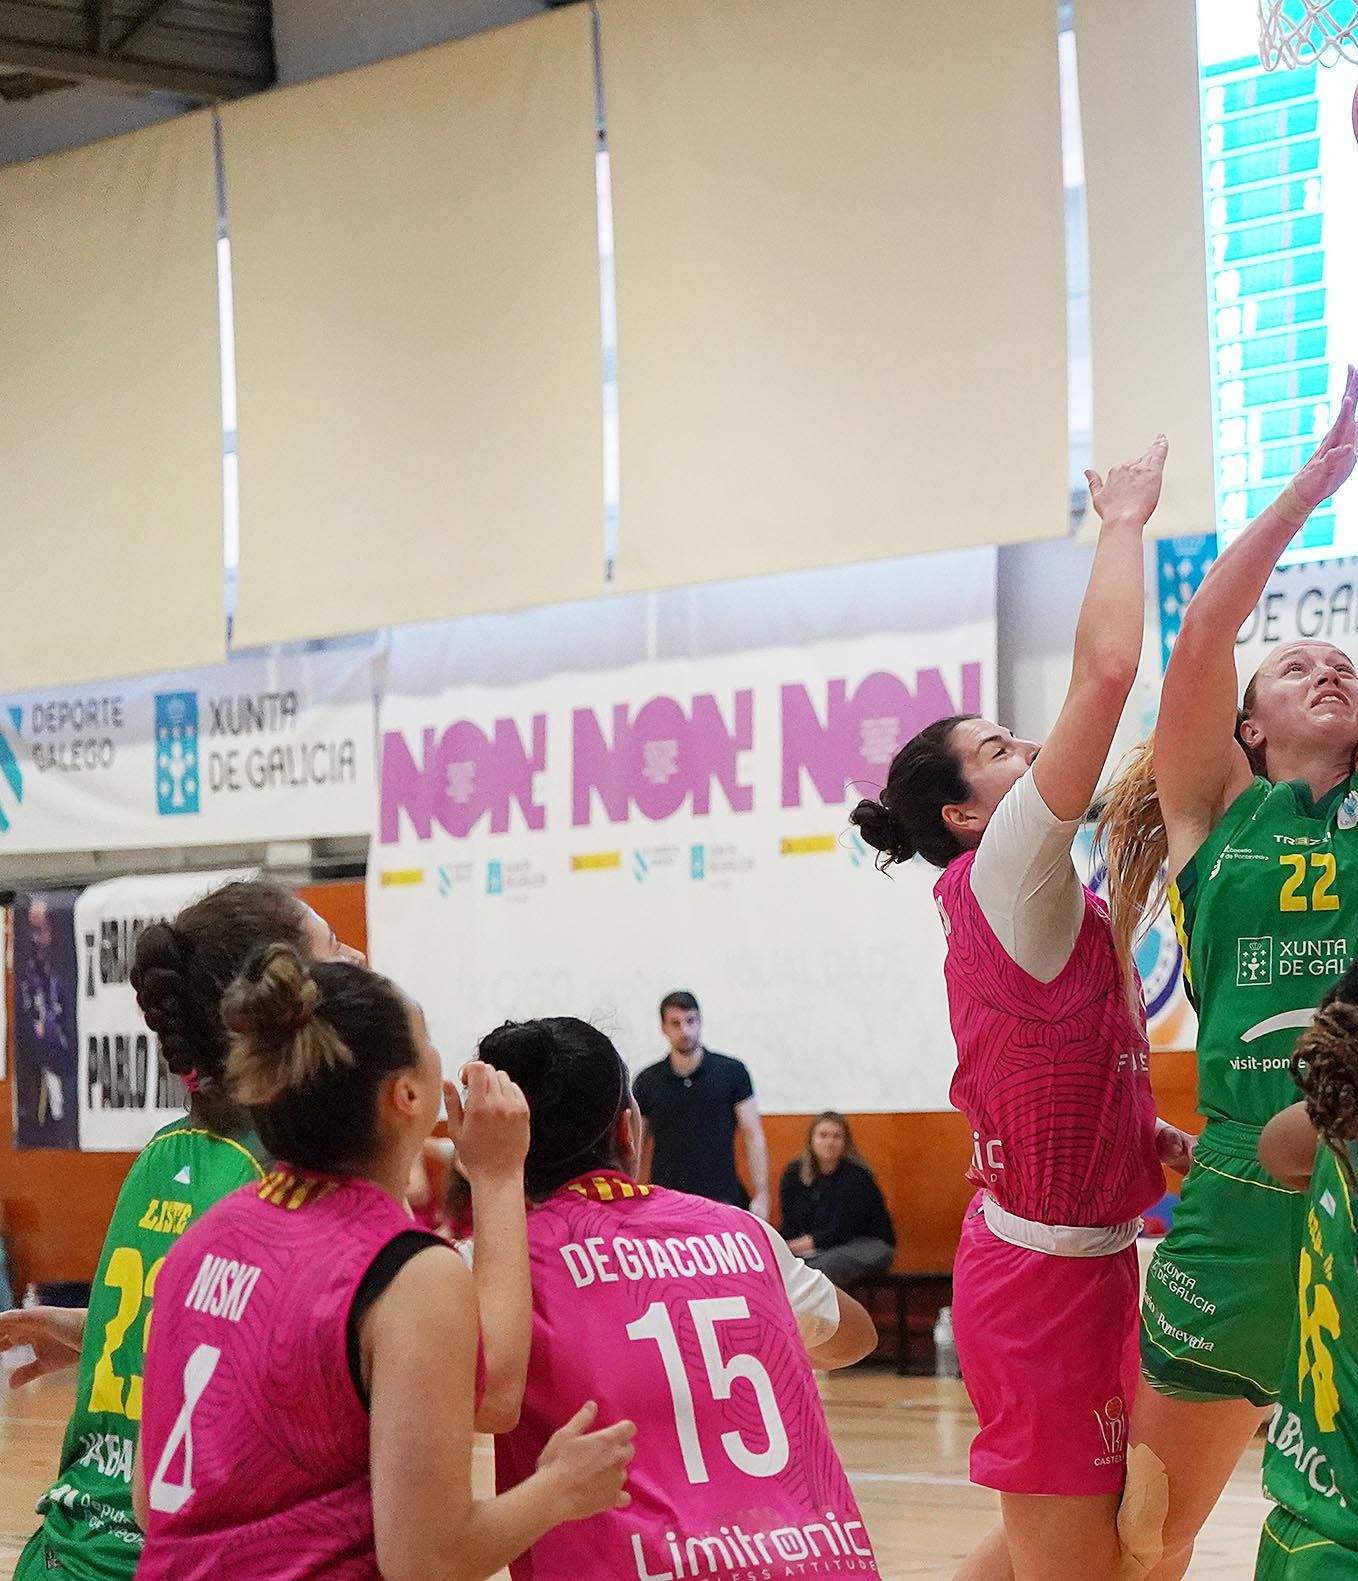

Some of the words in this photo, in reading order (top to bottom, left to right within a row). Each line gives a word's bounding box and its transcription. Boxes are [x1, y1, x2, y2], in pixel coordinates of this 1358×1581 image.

[31, 699, 125, 734] DEPORTE
[208, 690, 298, 737] XUNTA
[32, 737, 115, 772] GALEGO
[207, 751, 241, 793] DE
[249, 739, 356, 789] GALICIA
[1279, 852, 1340, 912] 22
[1280, 939, 1347, 957] XUNTA
[1279, 960, 1304, 976] DE
[1308, 957, 1354, 975] GAL
[1230, 1055, 1307, 1072] visit-pone
[560, 1237, 619, 1289] DE
[616, 1231, 766, 1284] GIACOMO
[1162, 1261, 1197, 1290] XUNTA
[184, 1253, 261, 1322] NISKI
[1168, 1280, 1217, 1316] GALICIA
[625, 1295, 791, 1485] 15
[149, 1343, 221, 1513] 6
[785, 1559, 877, 1577] ATTITUDE
